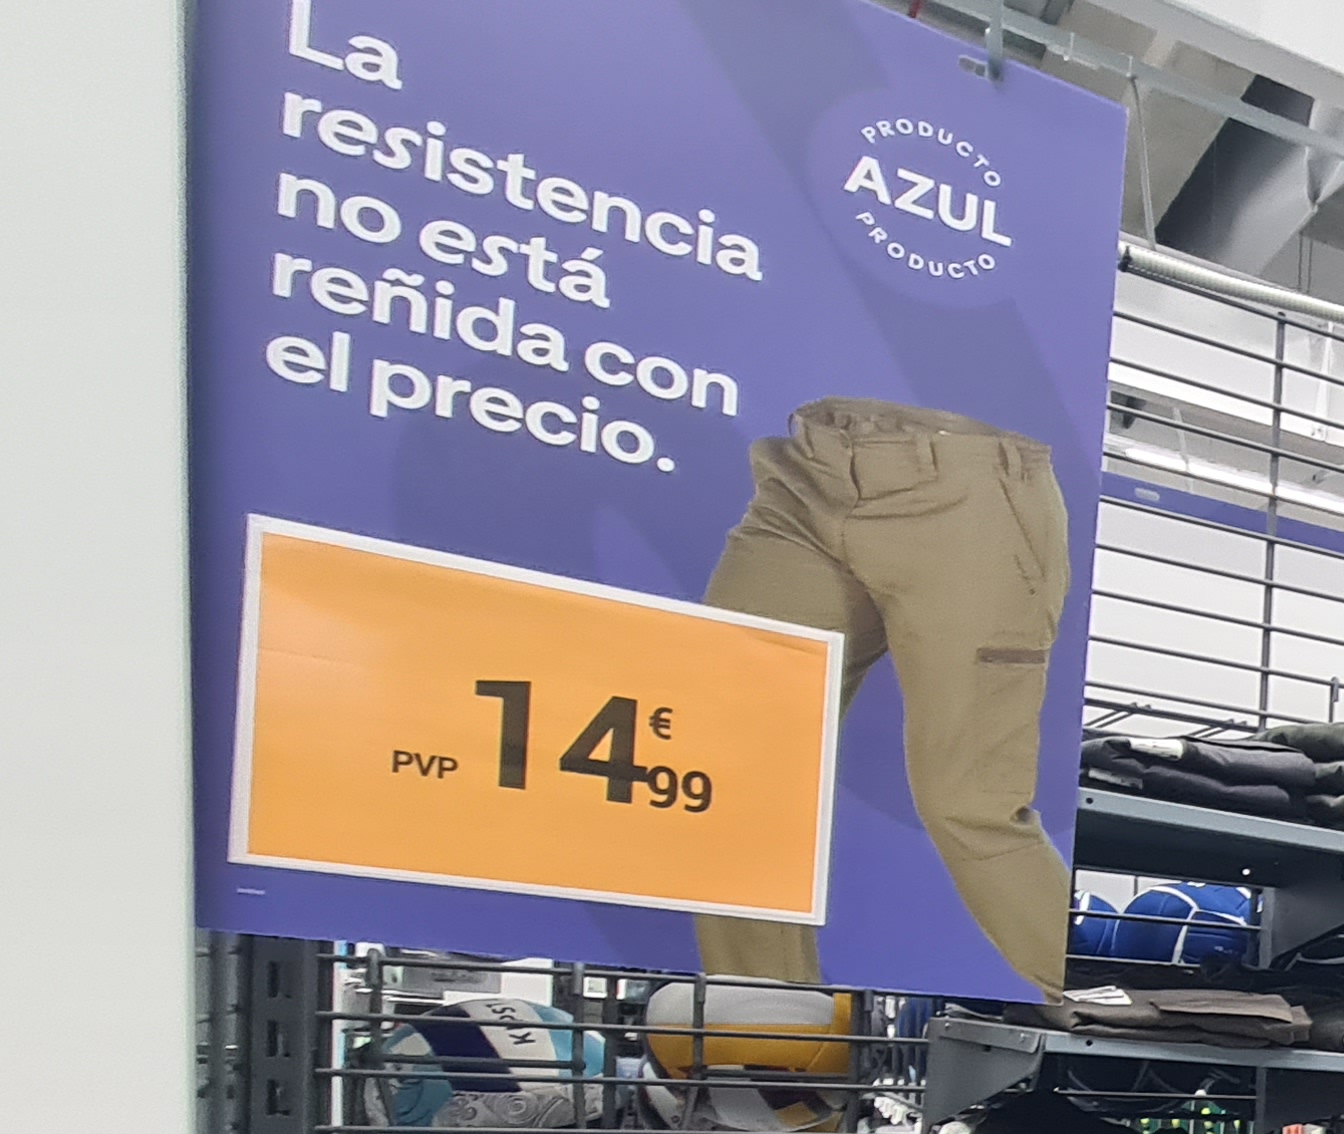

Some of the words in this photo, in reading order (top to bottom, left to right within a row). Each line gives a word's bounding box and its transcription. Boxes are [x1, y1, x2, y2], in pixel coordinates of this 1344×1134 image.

[289, 0, 404, 90] La
[283, 92, 764, 281] resistencia
[860, 118, 1002, 189] PRODUCTO
[277, 173, 402, 244] no
[419, 220, 611, 309] está
[844, 156, 1013, 247] AZUL
[854, 211, 996, 280] PRODUCTO
[272, 253, 570, 372] reñida
[585, 342, 739, 417] con
[266, 331, 351, 393] el
[369, 358, 676, 472] precio.
[392, 750, 458, 779] PVP
[475, 679, 649, 804] 14
[649, 707, 673, 740] €
[646, 764, 713, 813] 99
